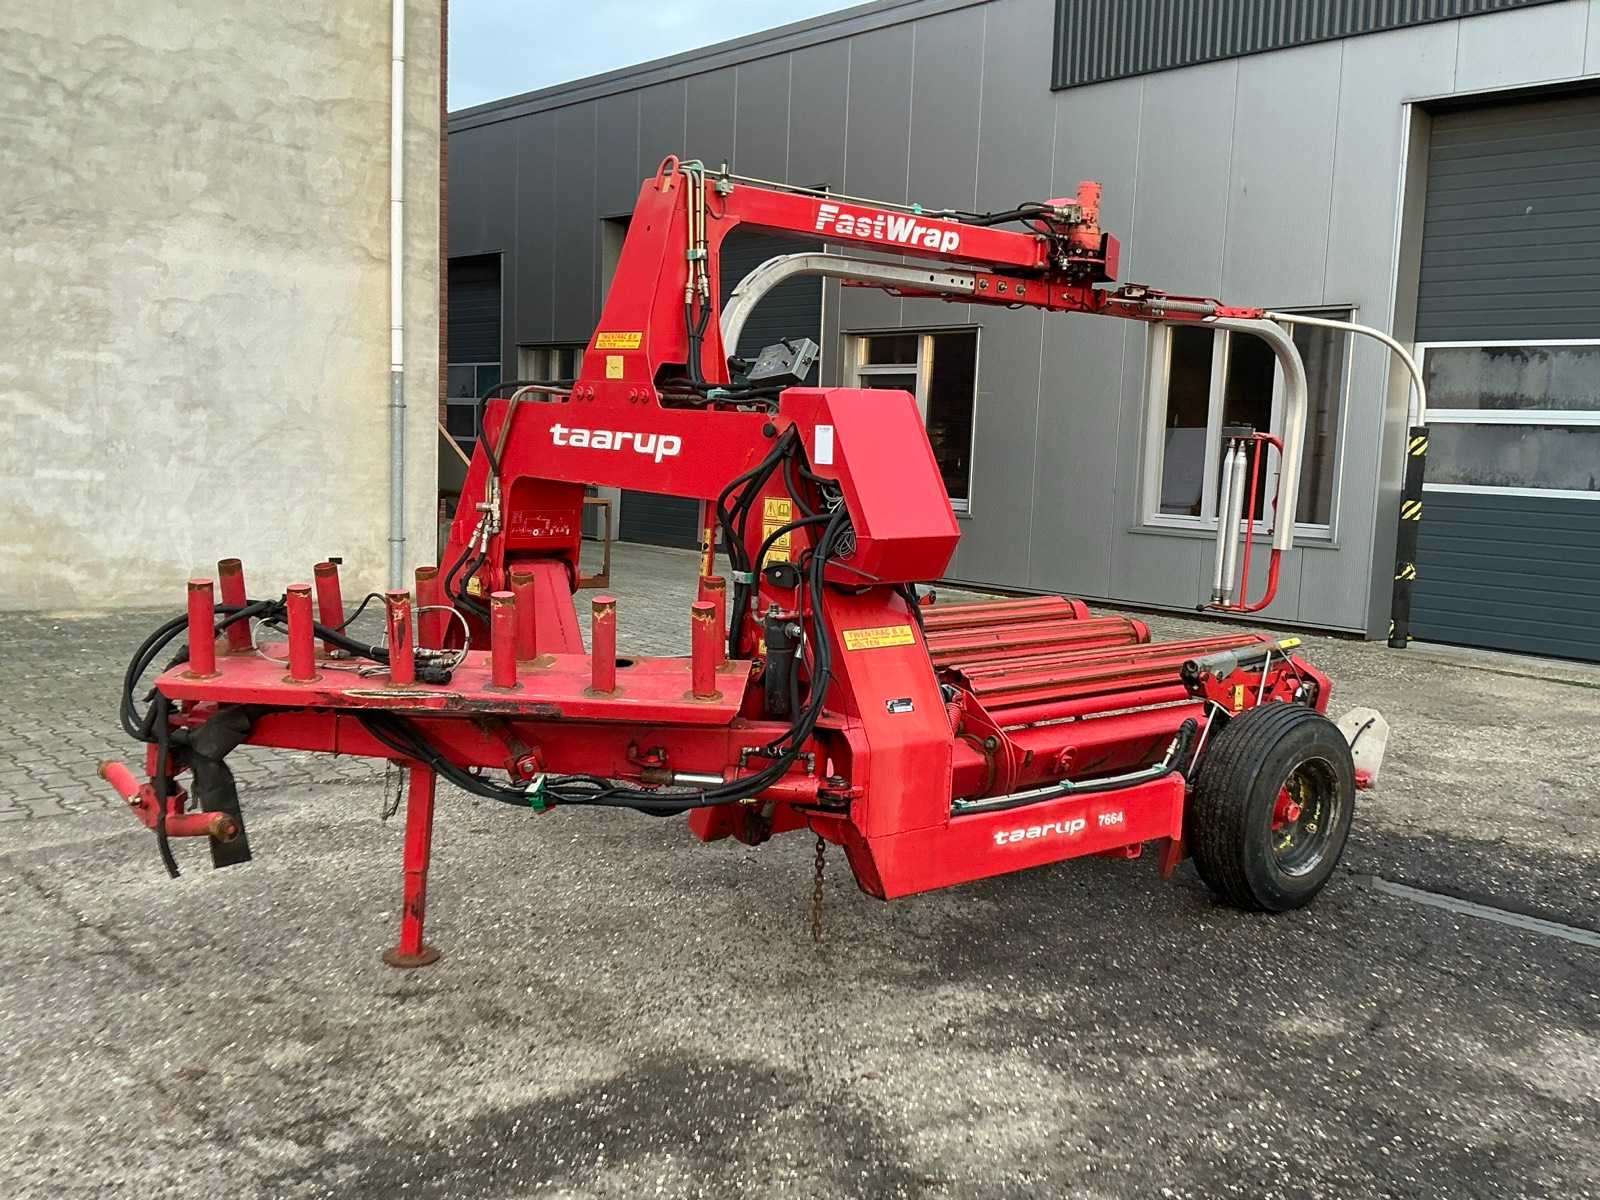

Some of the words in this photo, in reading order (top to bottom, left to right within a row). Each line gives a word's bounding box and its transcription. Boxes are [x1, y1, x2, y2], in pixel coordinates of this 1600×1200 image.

[815, 203, 960, 252] FastWrap
[549, 423, 682, 463] taarup
[993, 818, 1086, 845] taarup
[1098, 811, 1123, 826] 7664
